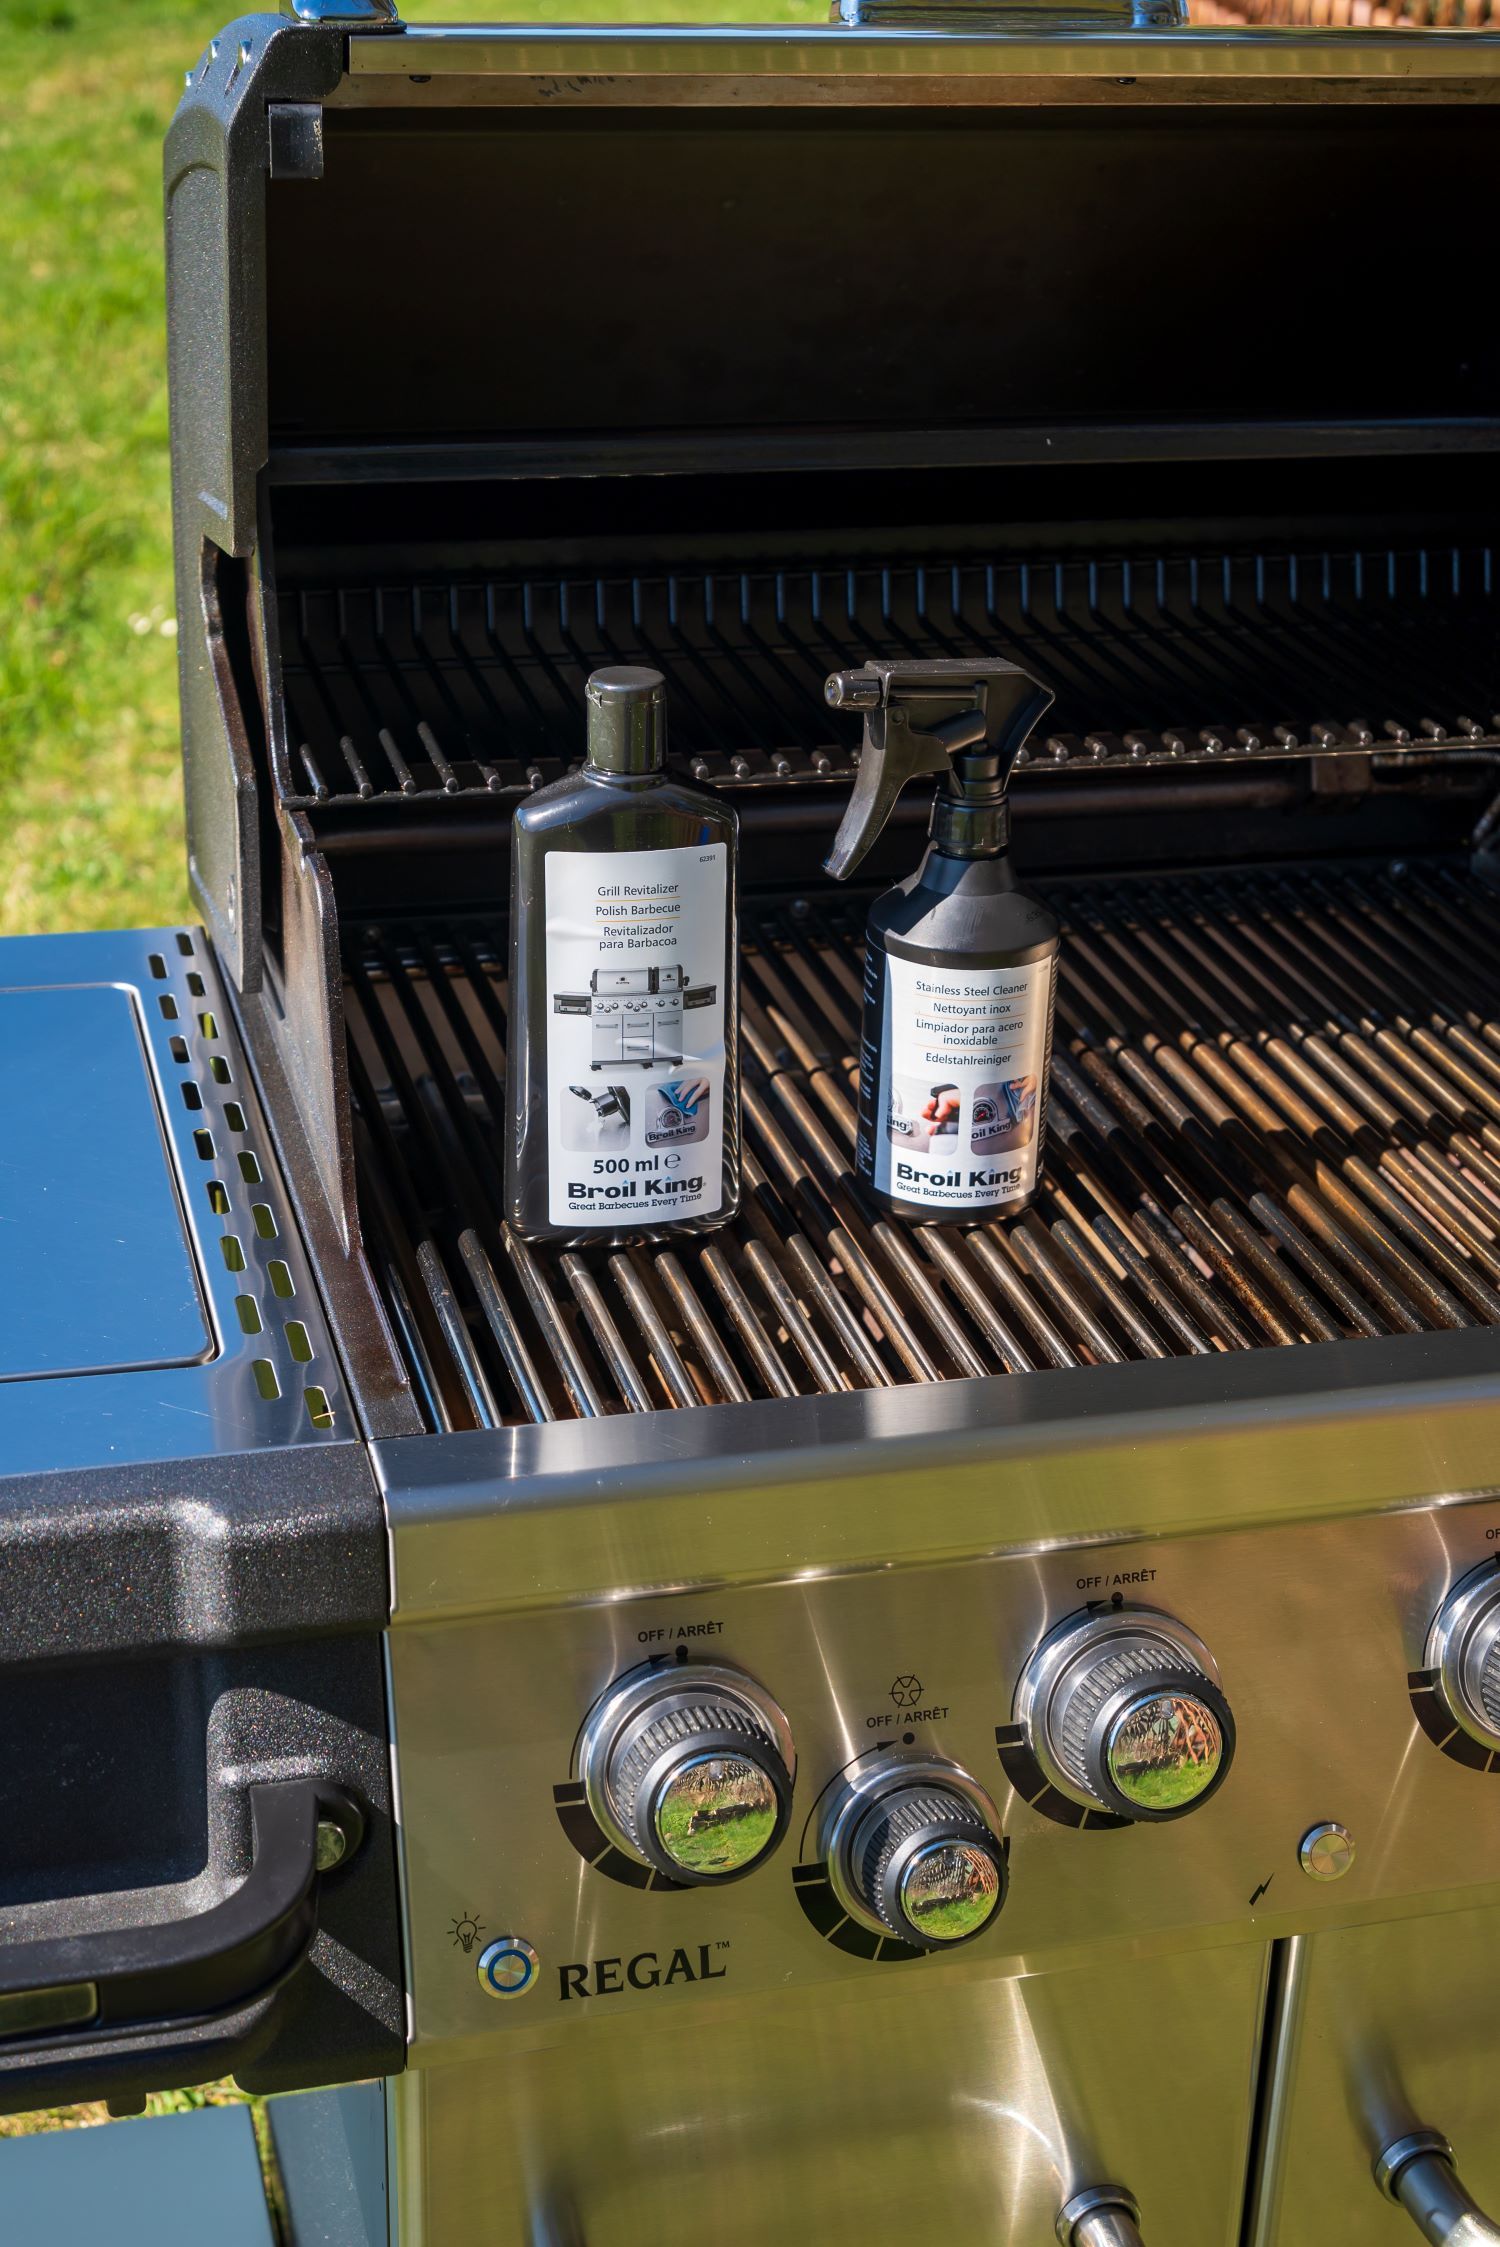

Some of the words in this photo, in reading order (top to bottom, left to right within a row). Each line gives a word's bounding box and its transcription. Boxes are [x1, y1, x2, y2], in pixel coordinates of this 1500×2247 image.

[597, 886, 620, 897] Grill
[624, 883, 679, 896] Revitalizer
[595, 905, 628, 916] Polish
[632, 903, 681, 915] Barbecue
[603, 924, 674, 937] Revitalizador
[599, 940, 624, 951] para
[627, 937, 678, 949] Barbacoa
[916, 981, 961, 996] Stainless
[964, 987, 990, 997] Steel
[993, 982, 1029, 996] Cleaner
[933, 1002, 987, 1016] Nettoyant
[989, 1004, 1011, 1014] inox
[916, 1019, 969, 1035] Limpiador
[972, 1025, 996, 1036] para
[998, 1020, 1024, 1032] acero
[943, 1035, 998, 1046] inoxidable
[925, 1052, 1013, 1067] Edelstahlreiniger
[649, 1130, 674, 1141] Broil
[676, 1126, 696, 1135] King
[988, 1123, 1010, 1135] King
[593, 1158, 630, 1174] 500
[635, 1154, 659, 1172] ml
[896, 1162, 961, 1187] Broil
[968, 1166, 1022, 1187] King
[567, 1179, 637, 1199] Broil
[644, 1176, 703, 1196] King
[896, 1181, 920, 1195] Great
[922, 1187, 973, 1199] Barbecues
[974, 1189, 1000, 1198] Every
[1001, 1183, 1021, 1193] Time
[568, 1202, 596, 1210] Great
[598, 1200, 650, 1211] Barbecues
[651, 1196, 678, 1207] Every
[680, 1193, 702, 1203] Time
[1076, 1576, 1102, 1590] OFF
[1112, 1568, 1157, 1586] ARRÊT
[637, 1629, 665, 1643] OFF
[676, 1620, 724, 1639] ARRÊT
[866, 1715, 893, 1729] OFF
[903, 1706, 949, 1724] ARRÊT
[556, 1943, 727, 2001] REGAL
